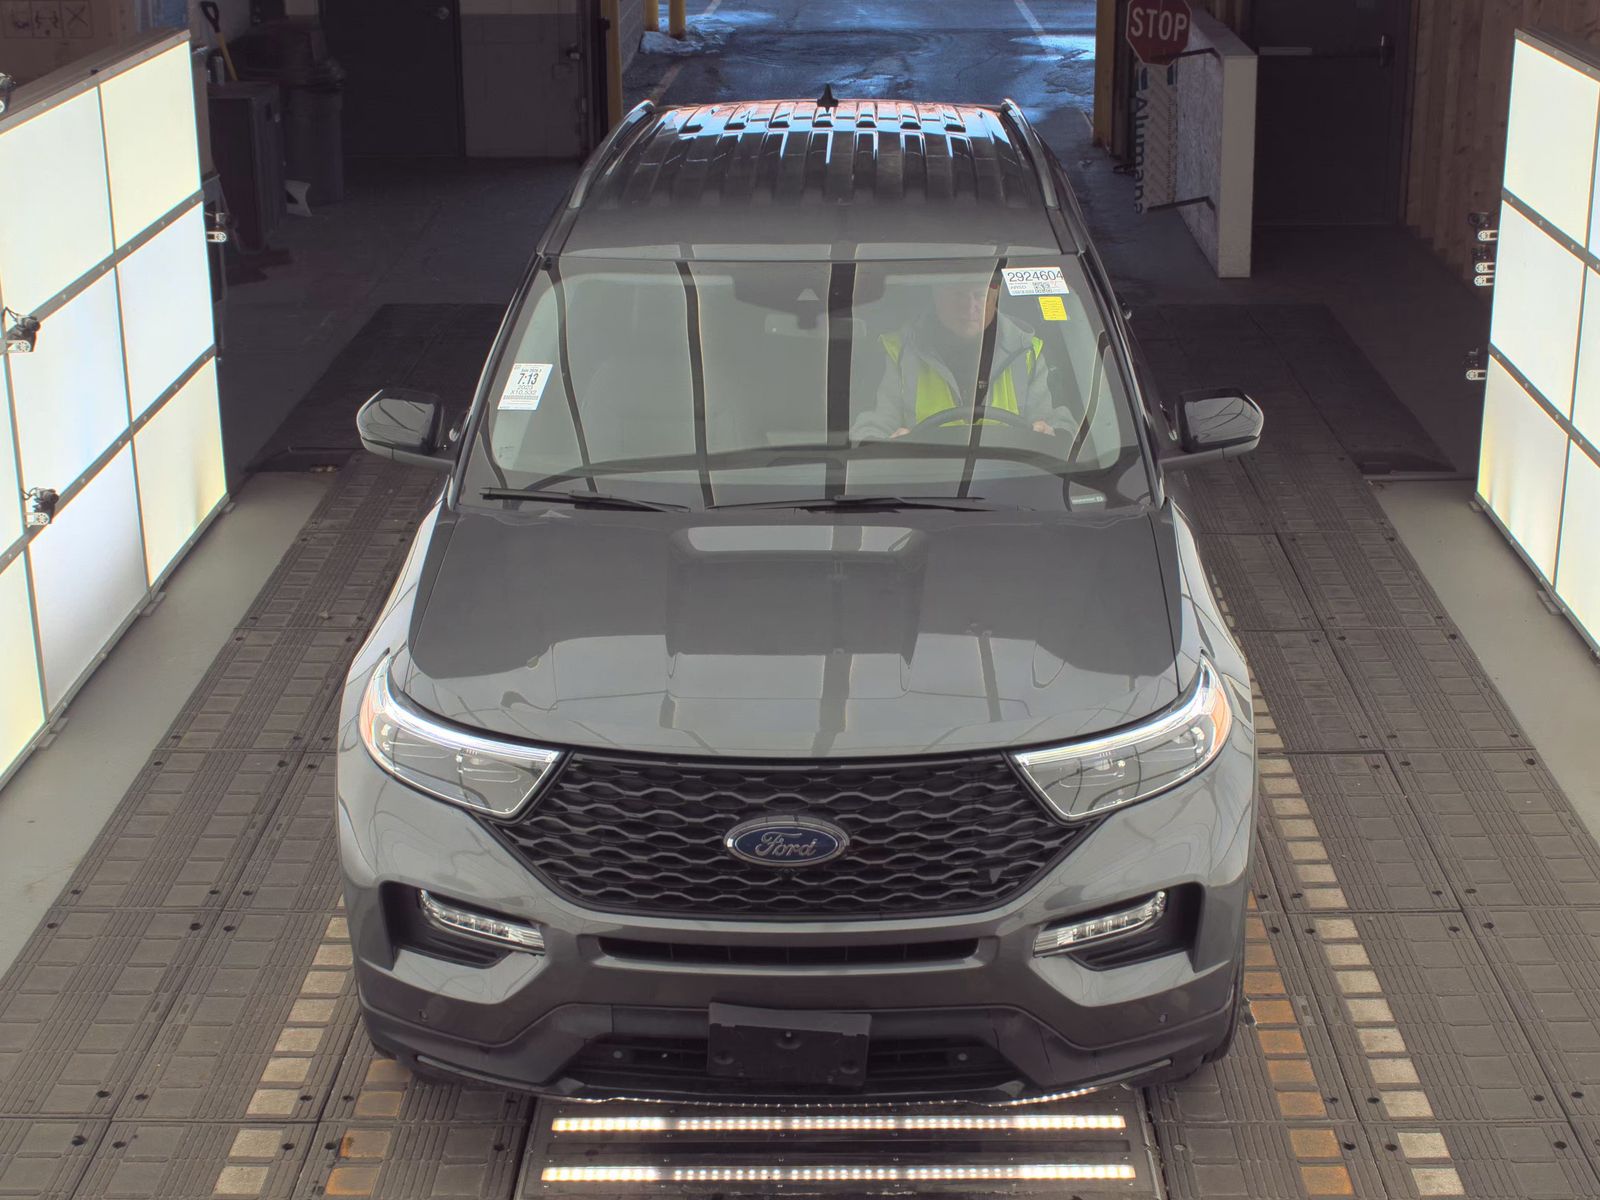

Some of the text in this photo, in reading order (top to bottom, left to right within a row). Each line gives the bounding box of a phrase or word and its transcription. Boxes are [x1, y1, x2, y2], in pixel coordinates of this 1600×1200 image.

[1131, 7, 1187, 41] STOP
[1007, 270, 1063, 283] 2924604
[517, 372, 539, 385] 7:13
[755, 831, 818, 856] Ford
